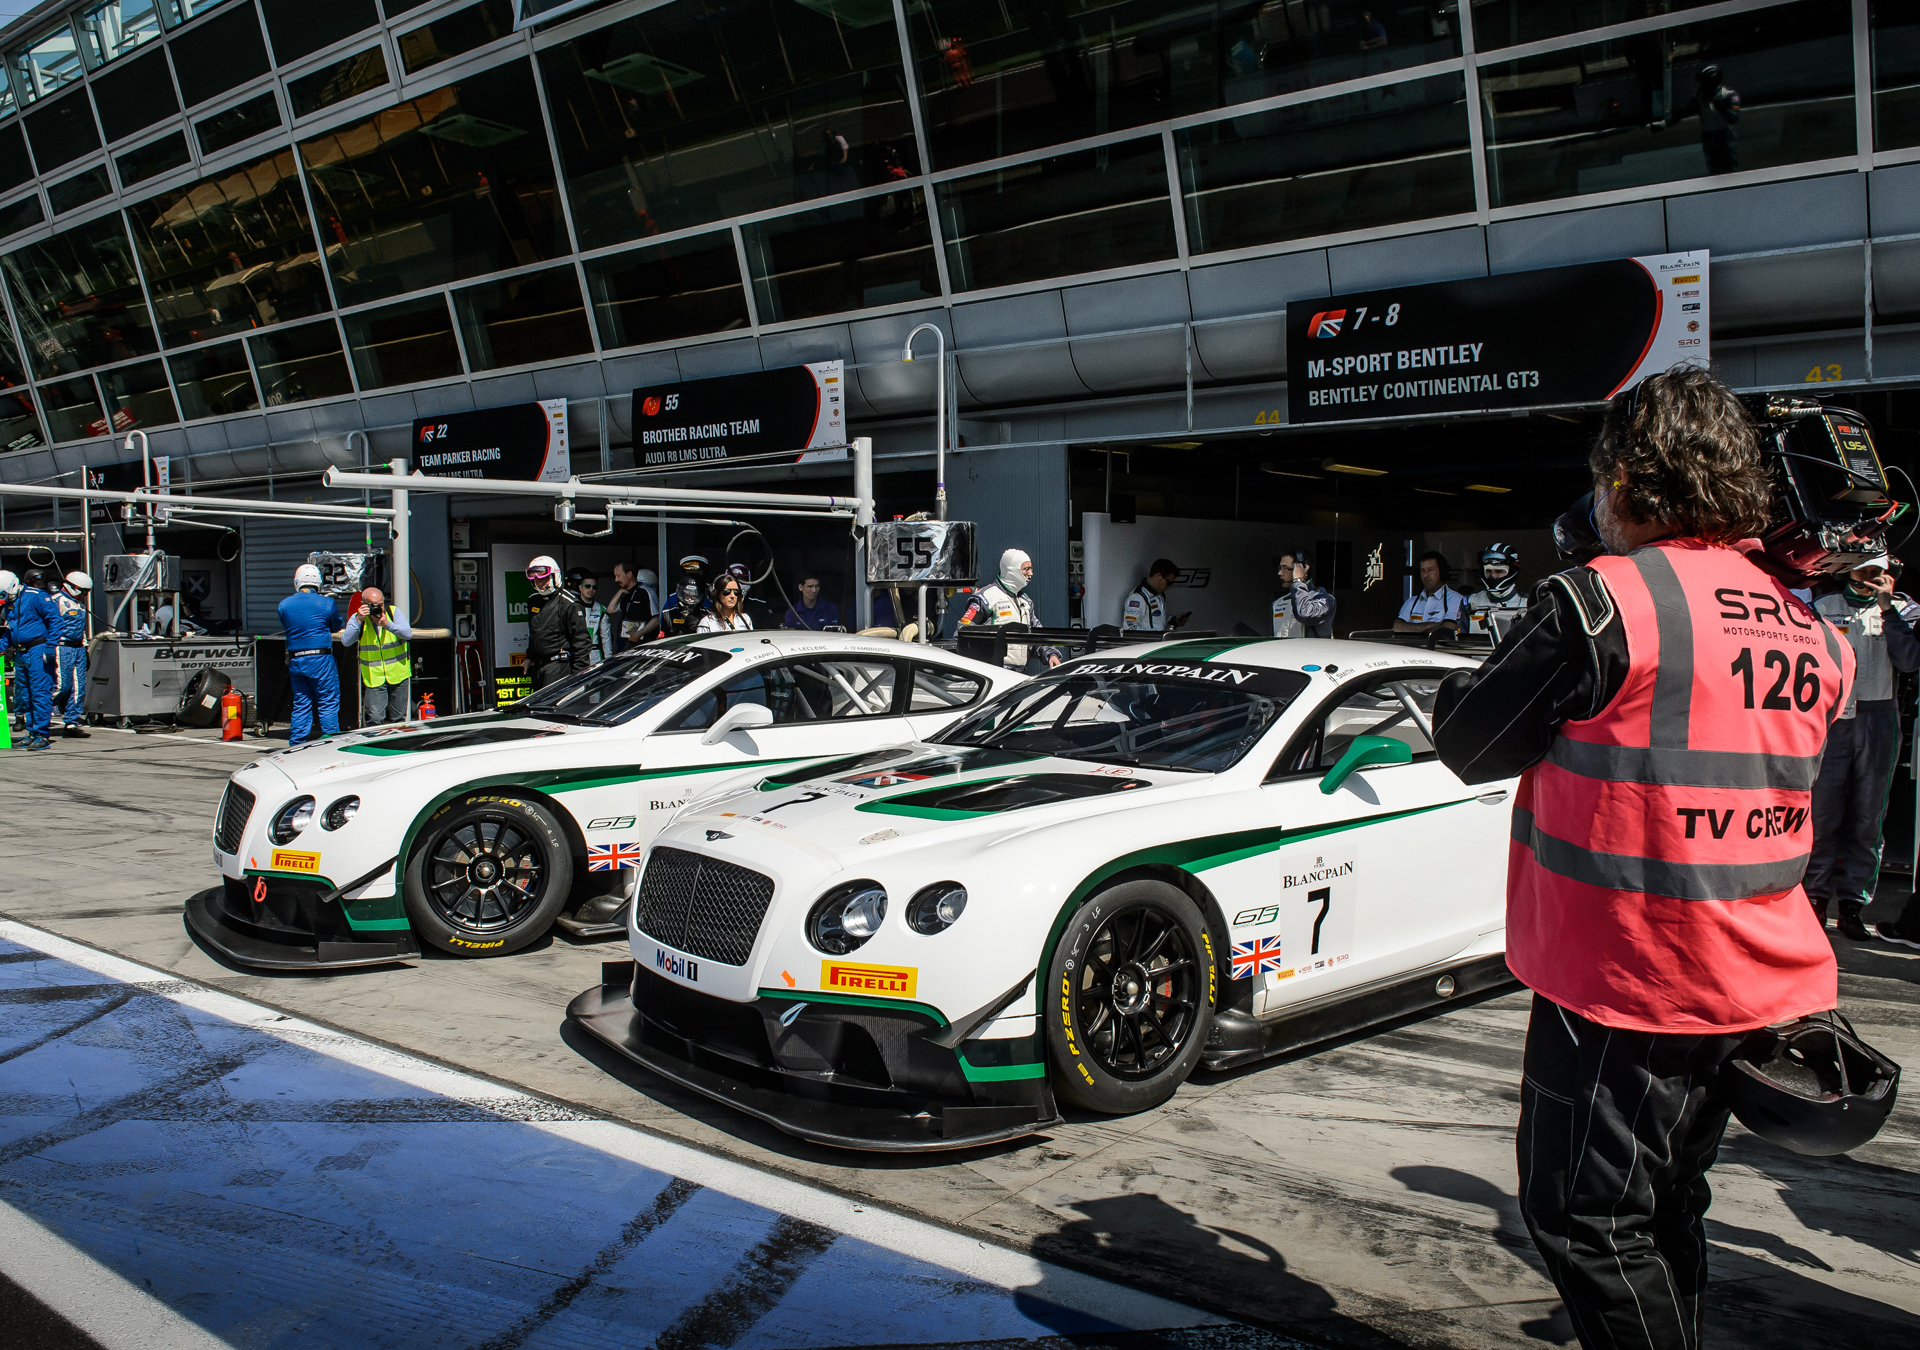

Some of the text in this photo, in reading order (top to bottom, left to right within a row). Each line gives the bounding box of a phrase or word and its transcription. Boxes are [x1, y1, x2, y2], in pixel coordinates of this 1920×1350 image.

[1660, 261, 1700, 270] BLANCPAIN
[1352, 307, 1368, 330] 7
[1386, 303, 1400, 326] 8
[1307, 342, 1484, 379] M-SPORT BENTLEY
[1805, 364, 1842, 382] 43
[1308, 371, 1540, 407] BENTLEY CONTINENTAL GT3
[665, 394, 679, 411] 55
[1254, 410, 1280, 425] 44
[436, 424, 448, 438] 22
[643, 419, 760, 444] BROTHER RACING TEAM
[645, 446, 728, 465] AUDI R8 LMS ULTRA
[1843, 441, 1867, 451] L95e
[420, 447, 500, 467] TEAM PARKER RACING
[897, 537, 932, 569] 55
[320, 563, 345, 585] 22
[1723, 626, 1789, 642] MOTORSPORTS
[181, 660, 252, 669] MOTORSPORT
[755, 651, 775, 661] TAPPY
[1065, 664, 1258, 685] BLANCPAIN
[1731, 647, 1820, 713] 126
[497, 688, 514, 699] 1ST
[586, 815, 637, 830] GT3
[1676, 805, 1810, 840] TV CREW
[275, 853, 315, 869] PIRELLI
[1283, 861, 1354, 889] BLANCPAIN
[1233, 904, 1279, 925] GT3
[1307, 886, 1331, 955] 7
[449, 937, 505, 949] PIRELLI
[656, 948, 685, 978] Mobil
[1202, 933, 1216, 1003] PIRELLI
[830, 966, 908, 992] PIRELLI
